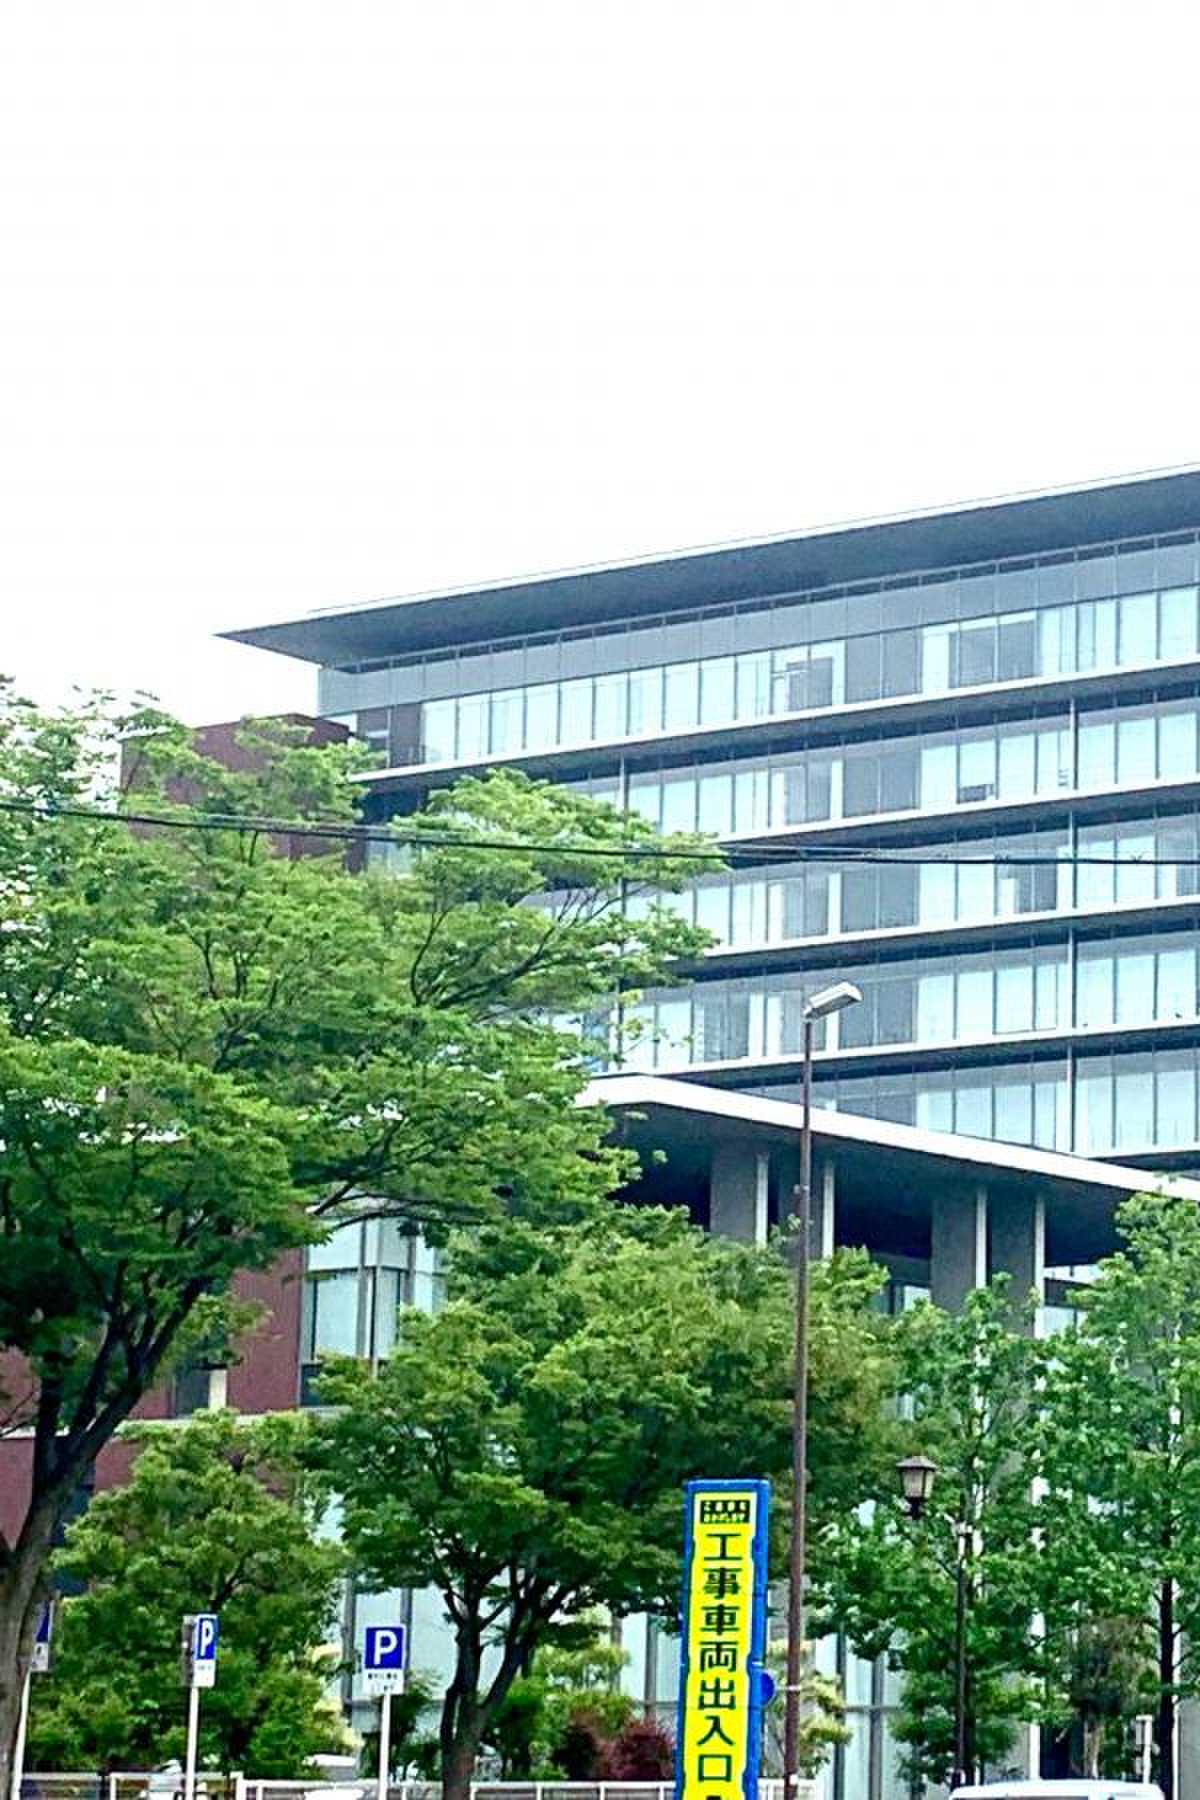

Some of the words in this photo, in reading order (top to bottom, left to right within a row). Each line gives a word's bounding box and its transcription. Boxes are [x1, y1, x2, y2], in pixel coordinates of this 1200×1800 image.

[200, 1620, 214, 1657] P
[373, 1630, 398, 1665] P
[697, 1532, 742, 1783] 工事車両出入口
